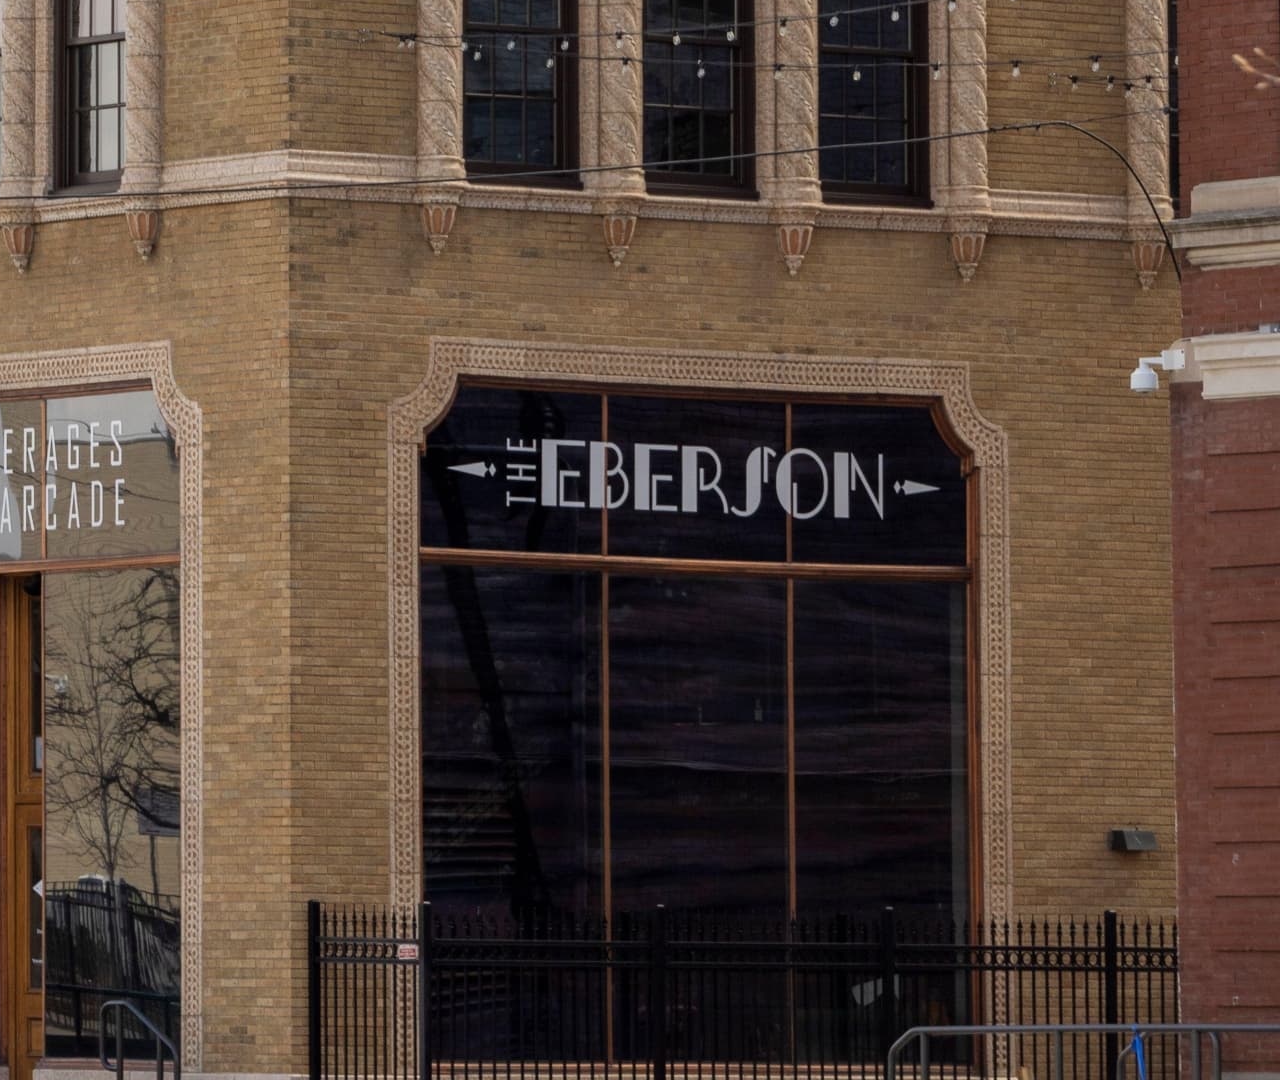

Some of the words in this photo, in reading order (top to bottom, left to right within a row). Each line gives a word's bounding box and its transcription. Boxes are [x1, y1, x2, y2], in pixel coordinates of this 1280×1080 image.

[0, 478, 125, 533] ARCADE
[506, 438, 536, 507] THE
[541, 438, 884, 520] EBERSON
